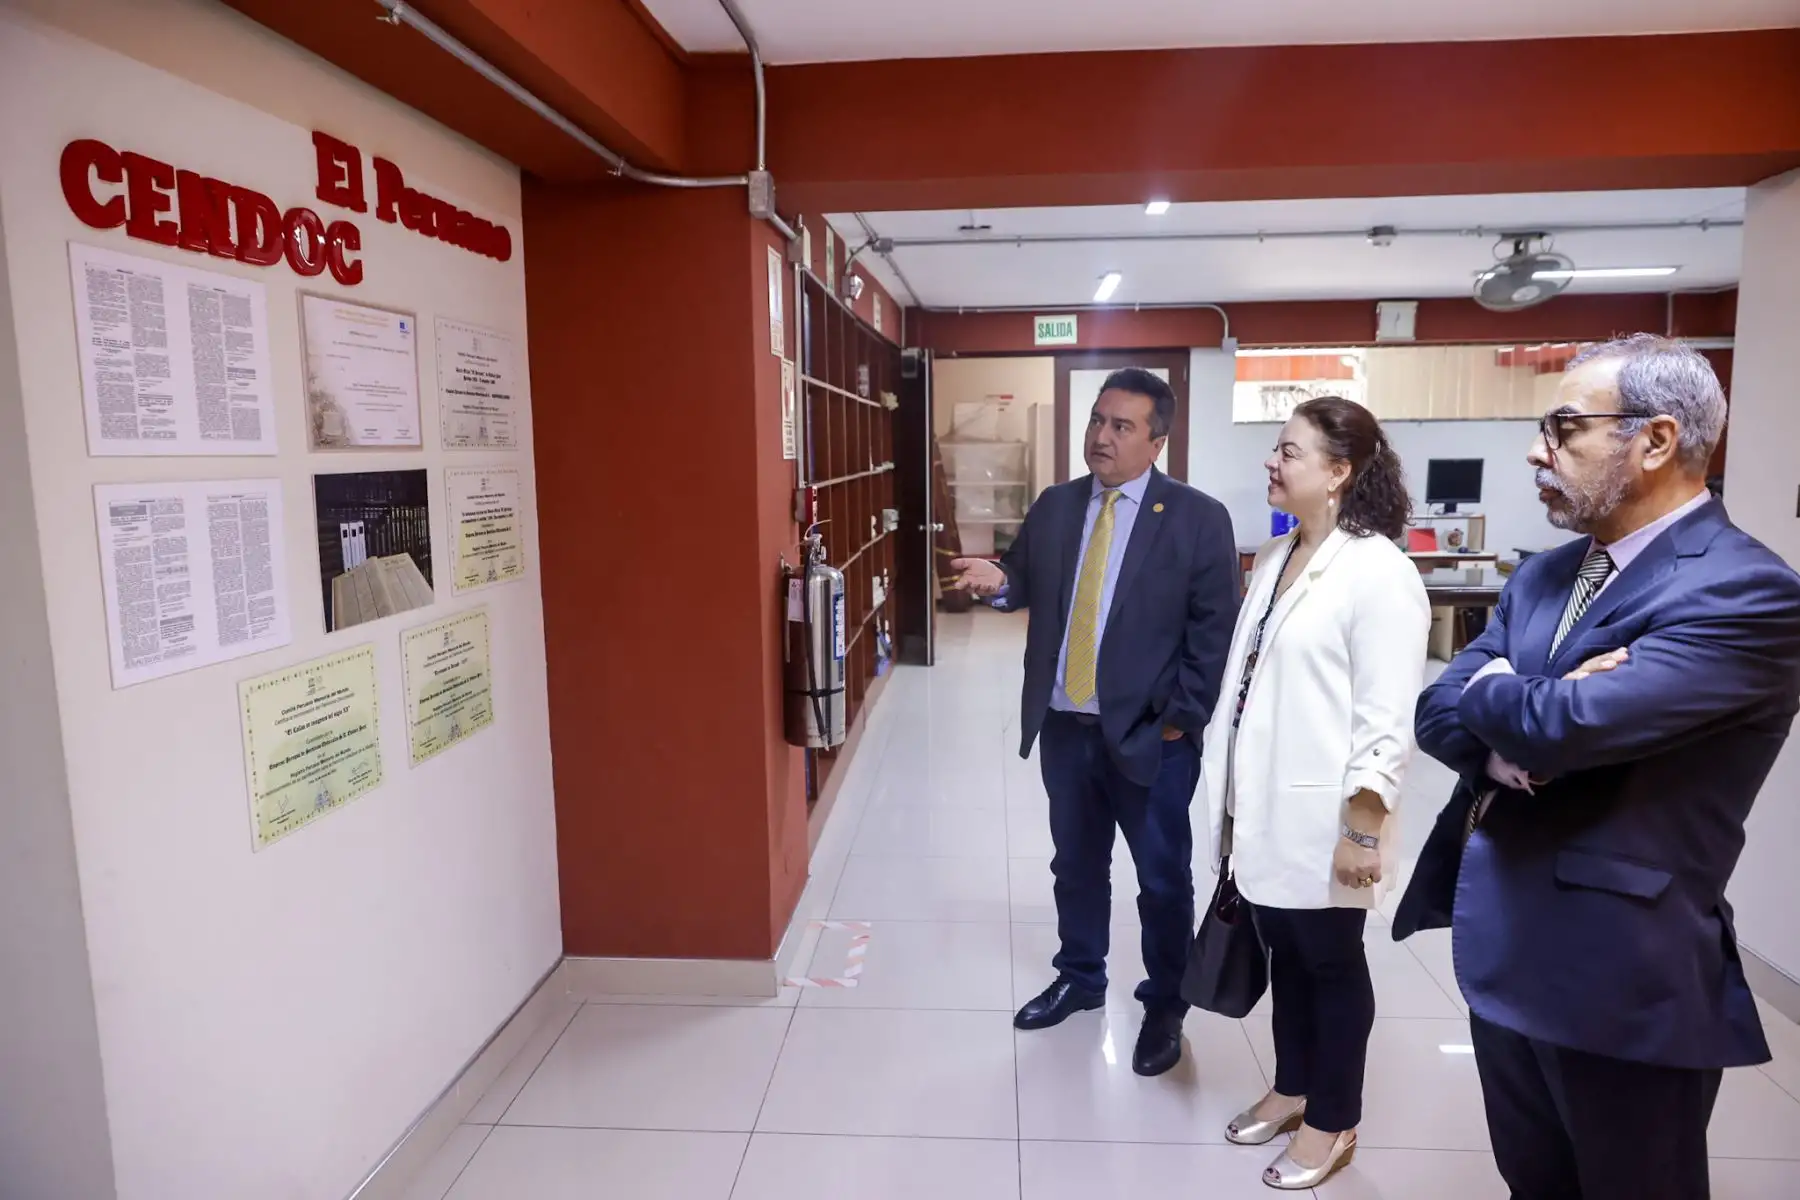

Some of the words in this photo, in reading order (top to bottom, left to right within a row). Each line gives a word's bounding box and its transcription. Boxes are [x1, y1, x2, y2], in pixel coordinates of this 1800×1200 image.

[60, 138, 363, 285] CENDOC
[312, 131, 367, 213] El
[1038, 322, 1073, 338] SALIDA
